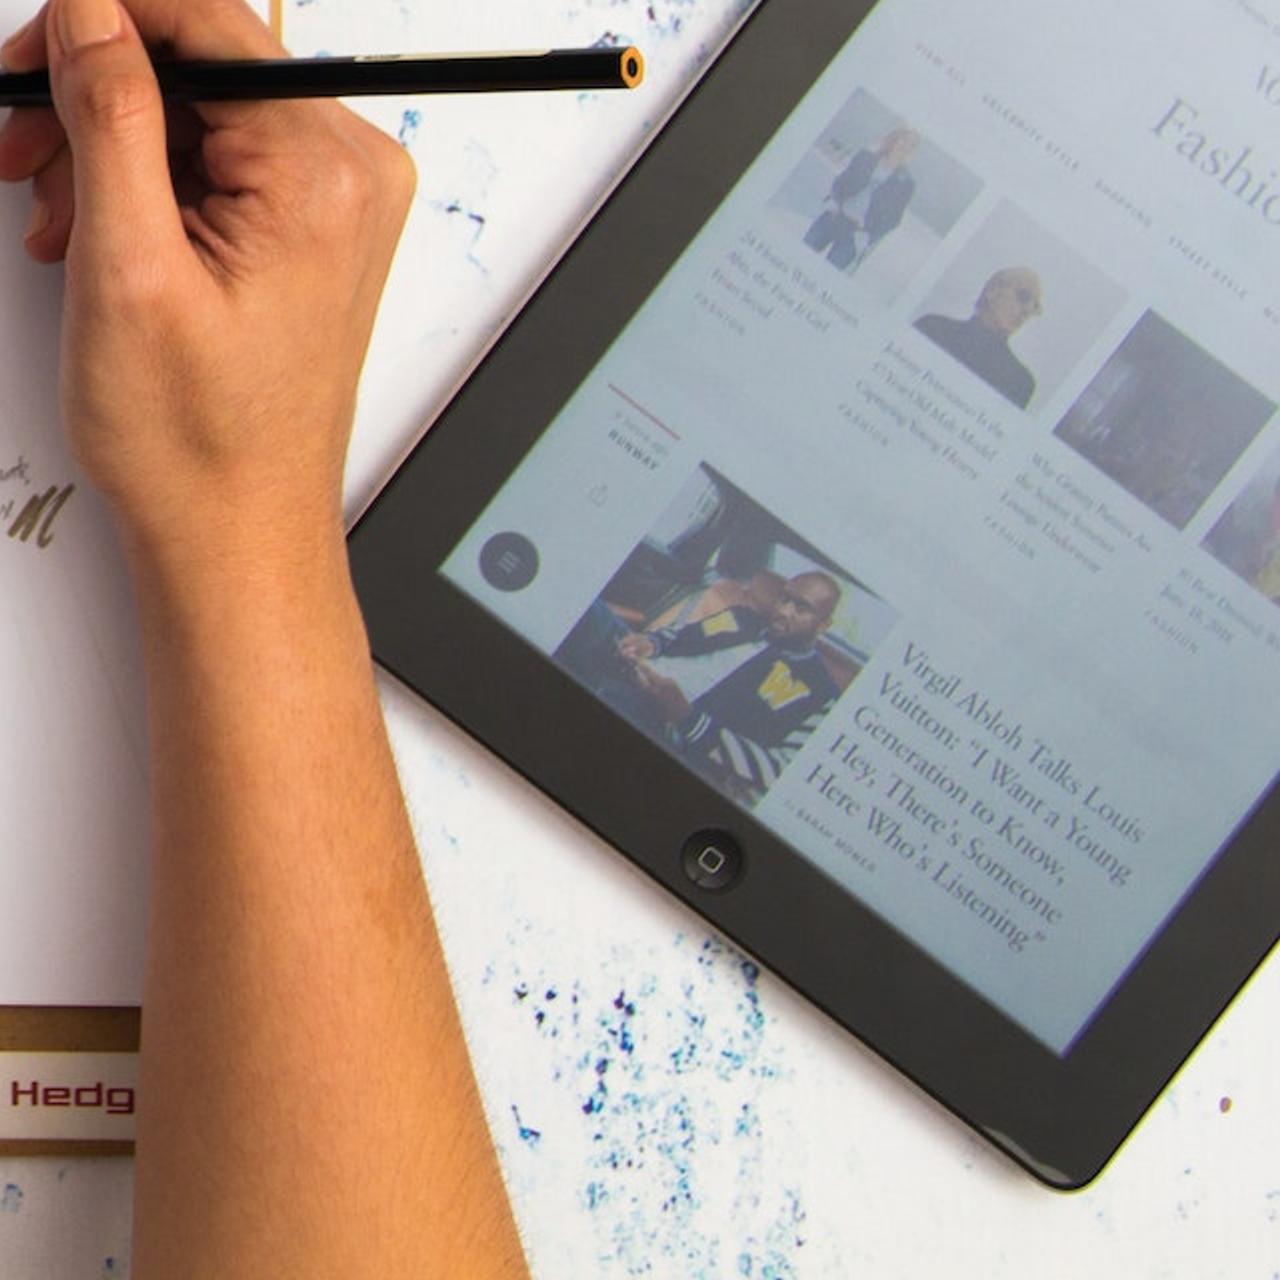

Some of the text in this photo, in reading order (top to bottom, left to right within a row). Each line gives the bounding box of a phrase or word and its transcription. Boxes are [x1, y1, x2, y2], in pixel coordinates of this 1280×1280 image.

[1150, 97, 1280, 225] Fashio
[805, 763, 860, 815] Here
[867, 806, 928, 872] Who's
[828, 733, 1062, 924] Hey, There's Someone
[853, 705, 1064, 886] Generation to Know,
[879, 671, 960, 751] Vuitton:
[991, 758, 1044, 815] Want
[1043, 811, 1061, 829] a
[1065, 816, 1132, 887] Young
[903, 641, 1141, 843] Virgil Abloh Talks Louis
[11, 1080, 135, 1114] Hedg
